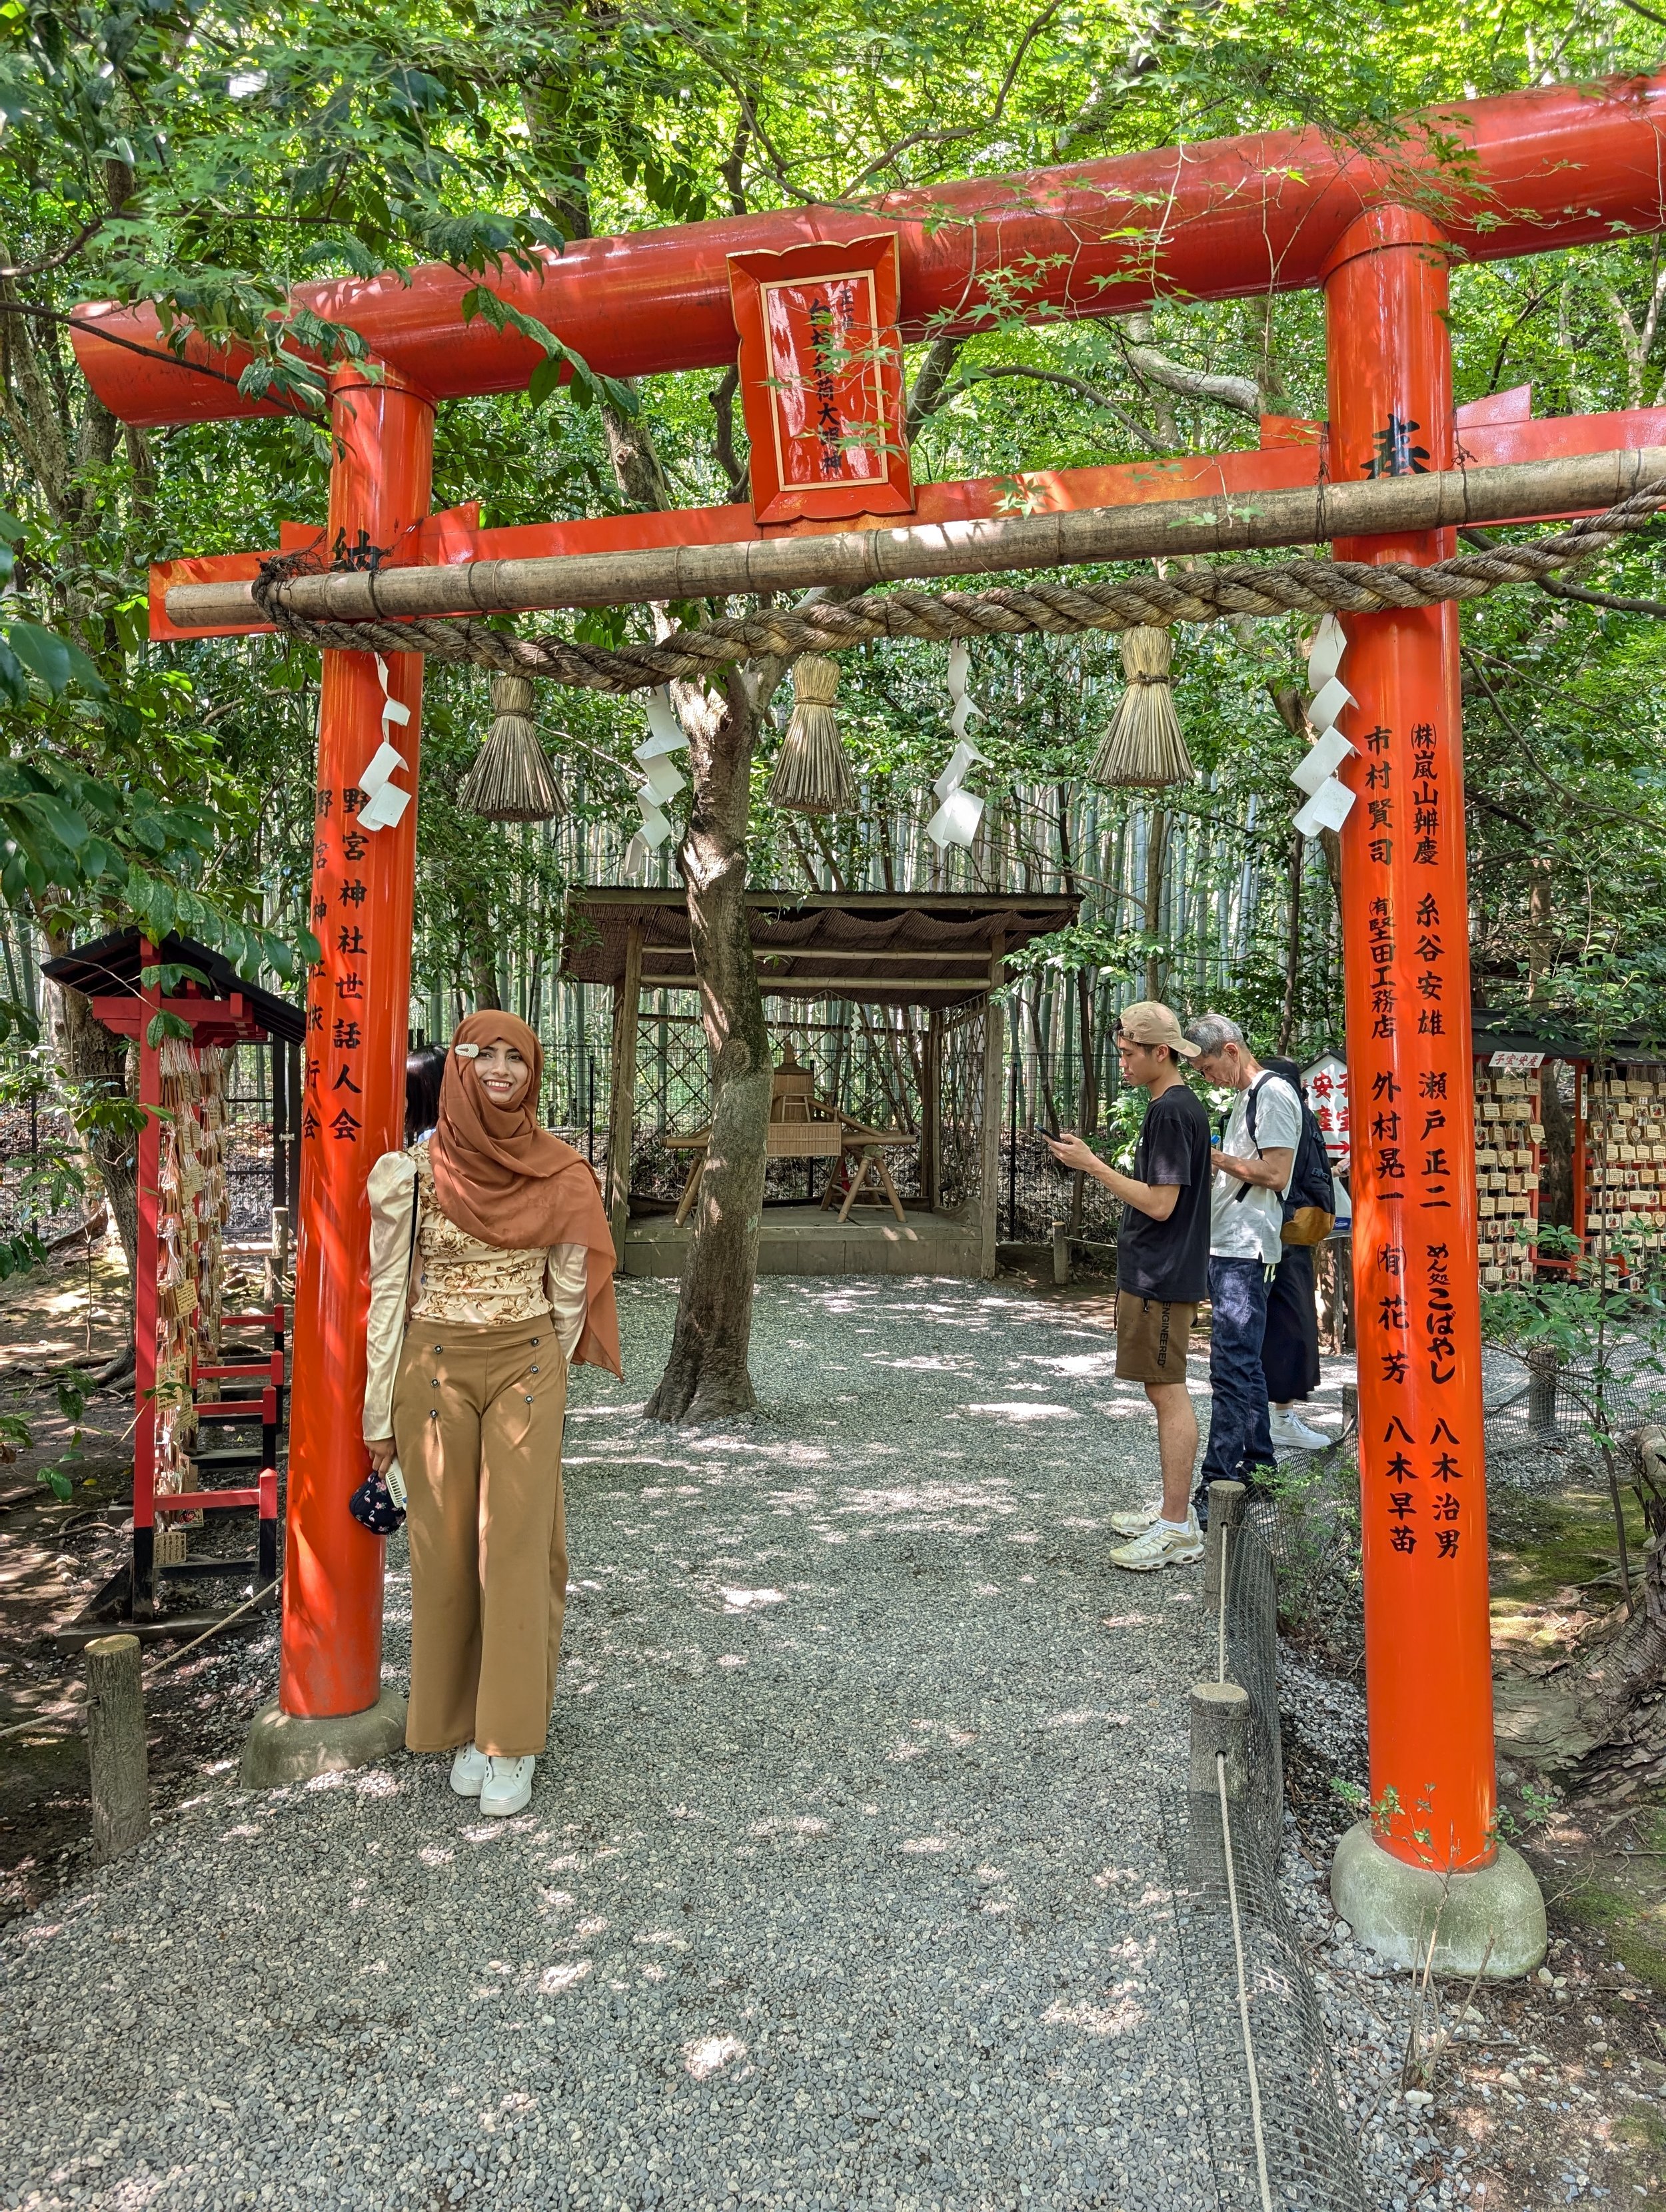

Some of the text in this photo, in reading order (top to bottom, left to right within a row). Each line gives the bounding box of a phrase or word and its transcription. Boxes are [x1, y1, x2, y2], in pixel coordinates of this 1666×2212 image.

[1363, 726, 1395, 866] 市村賢司
[329, 788, 371, 1143] 野宮神社世話人会
[1413, 892, 1445, 1037] 糸谷安雄
[1371, 1071, 1405, 1201] 外村晃一
[1418, 1071, 1451, 1208] 瀬戸正二
[1383, 1415, 1419, 1555] 八木早苗
[1429, 1417, 1463, 1559] 八木治男
